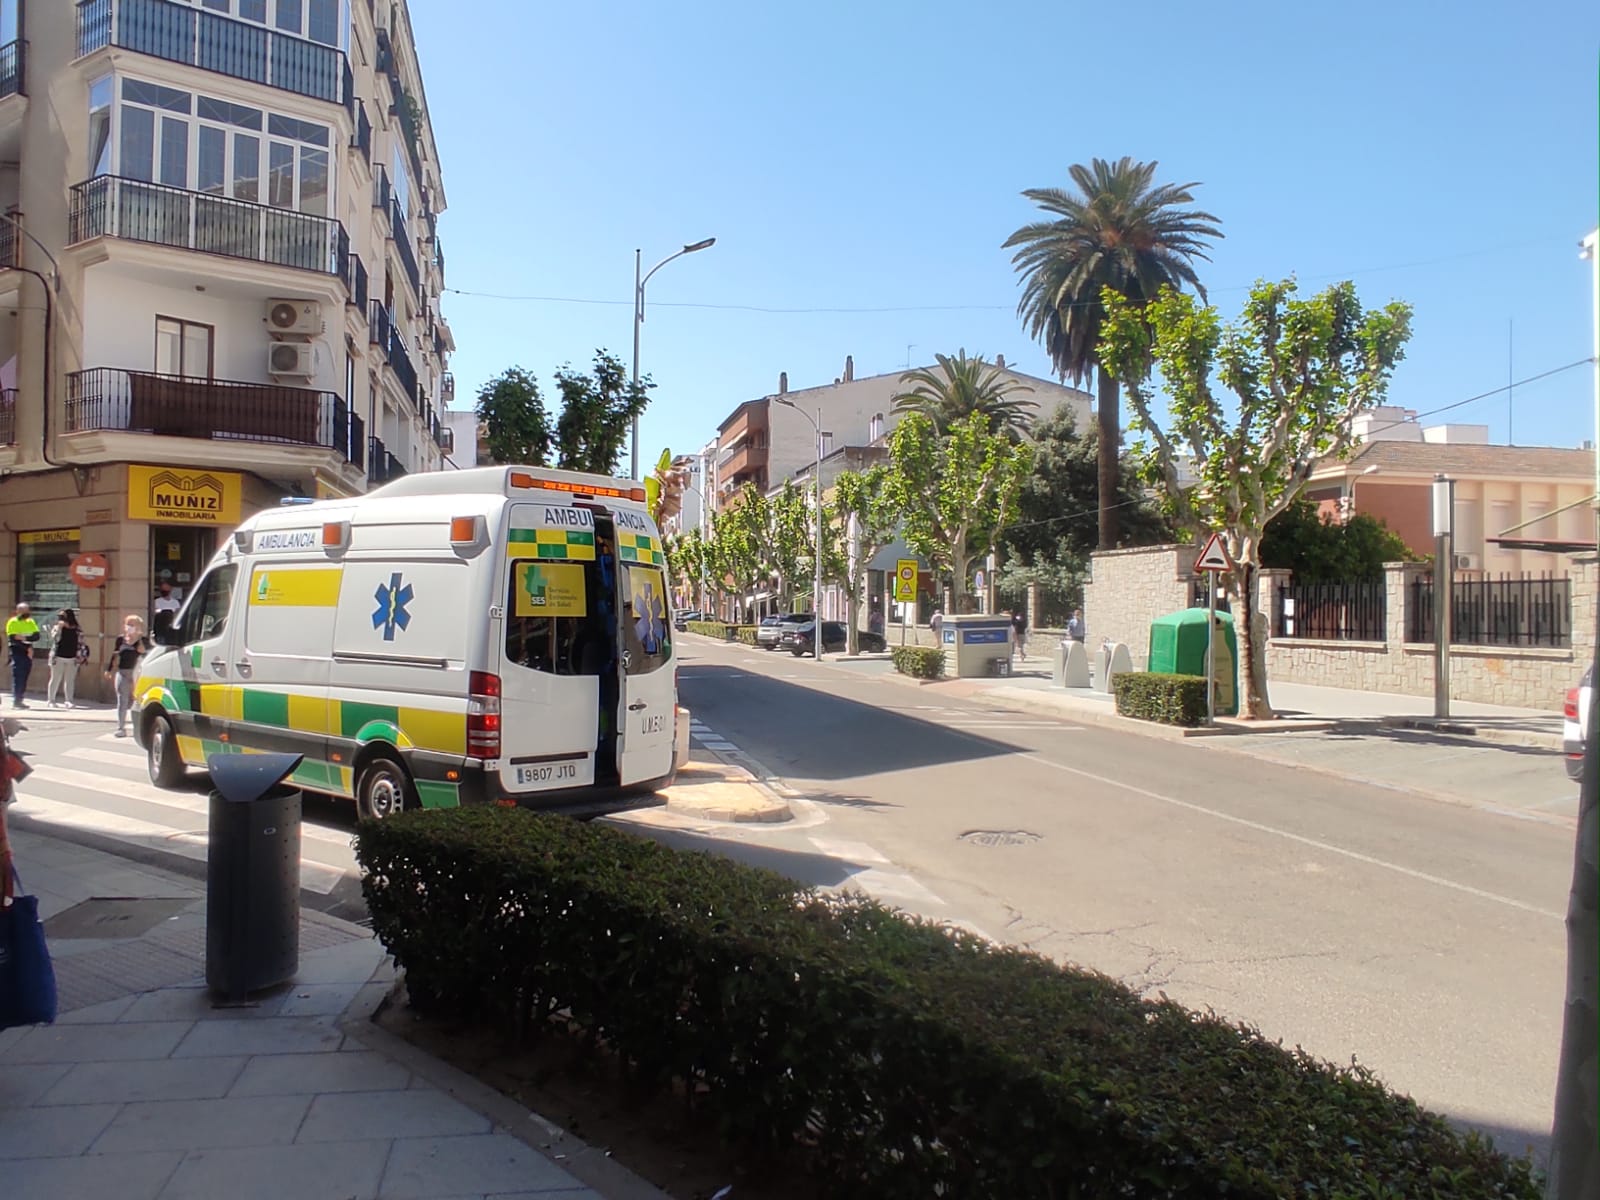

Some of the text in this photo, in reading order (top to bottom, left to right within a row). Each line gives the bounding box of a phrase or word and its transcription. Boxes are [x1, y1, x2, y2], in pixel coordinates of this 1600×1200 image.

[156, 493, 217, 509] MUÑIZ
[156, 510, 217, 520] INMOBILIARIA
[258, 532, 316, 549] AMBULANCIA
[531, 596, 546, 605] SES
[525, 765, 576, 782] 9807 JTD
